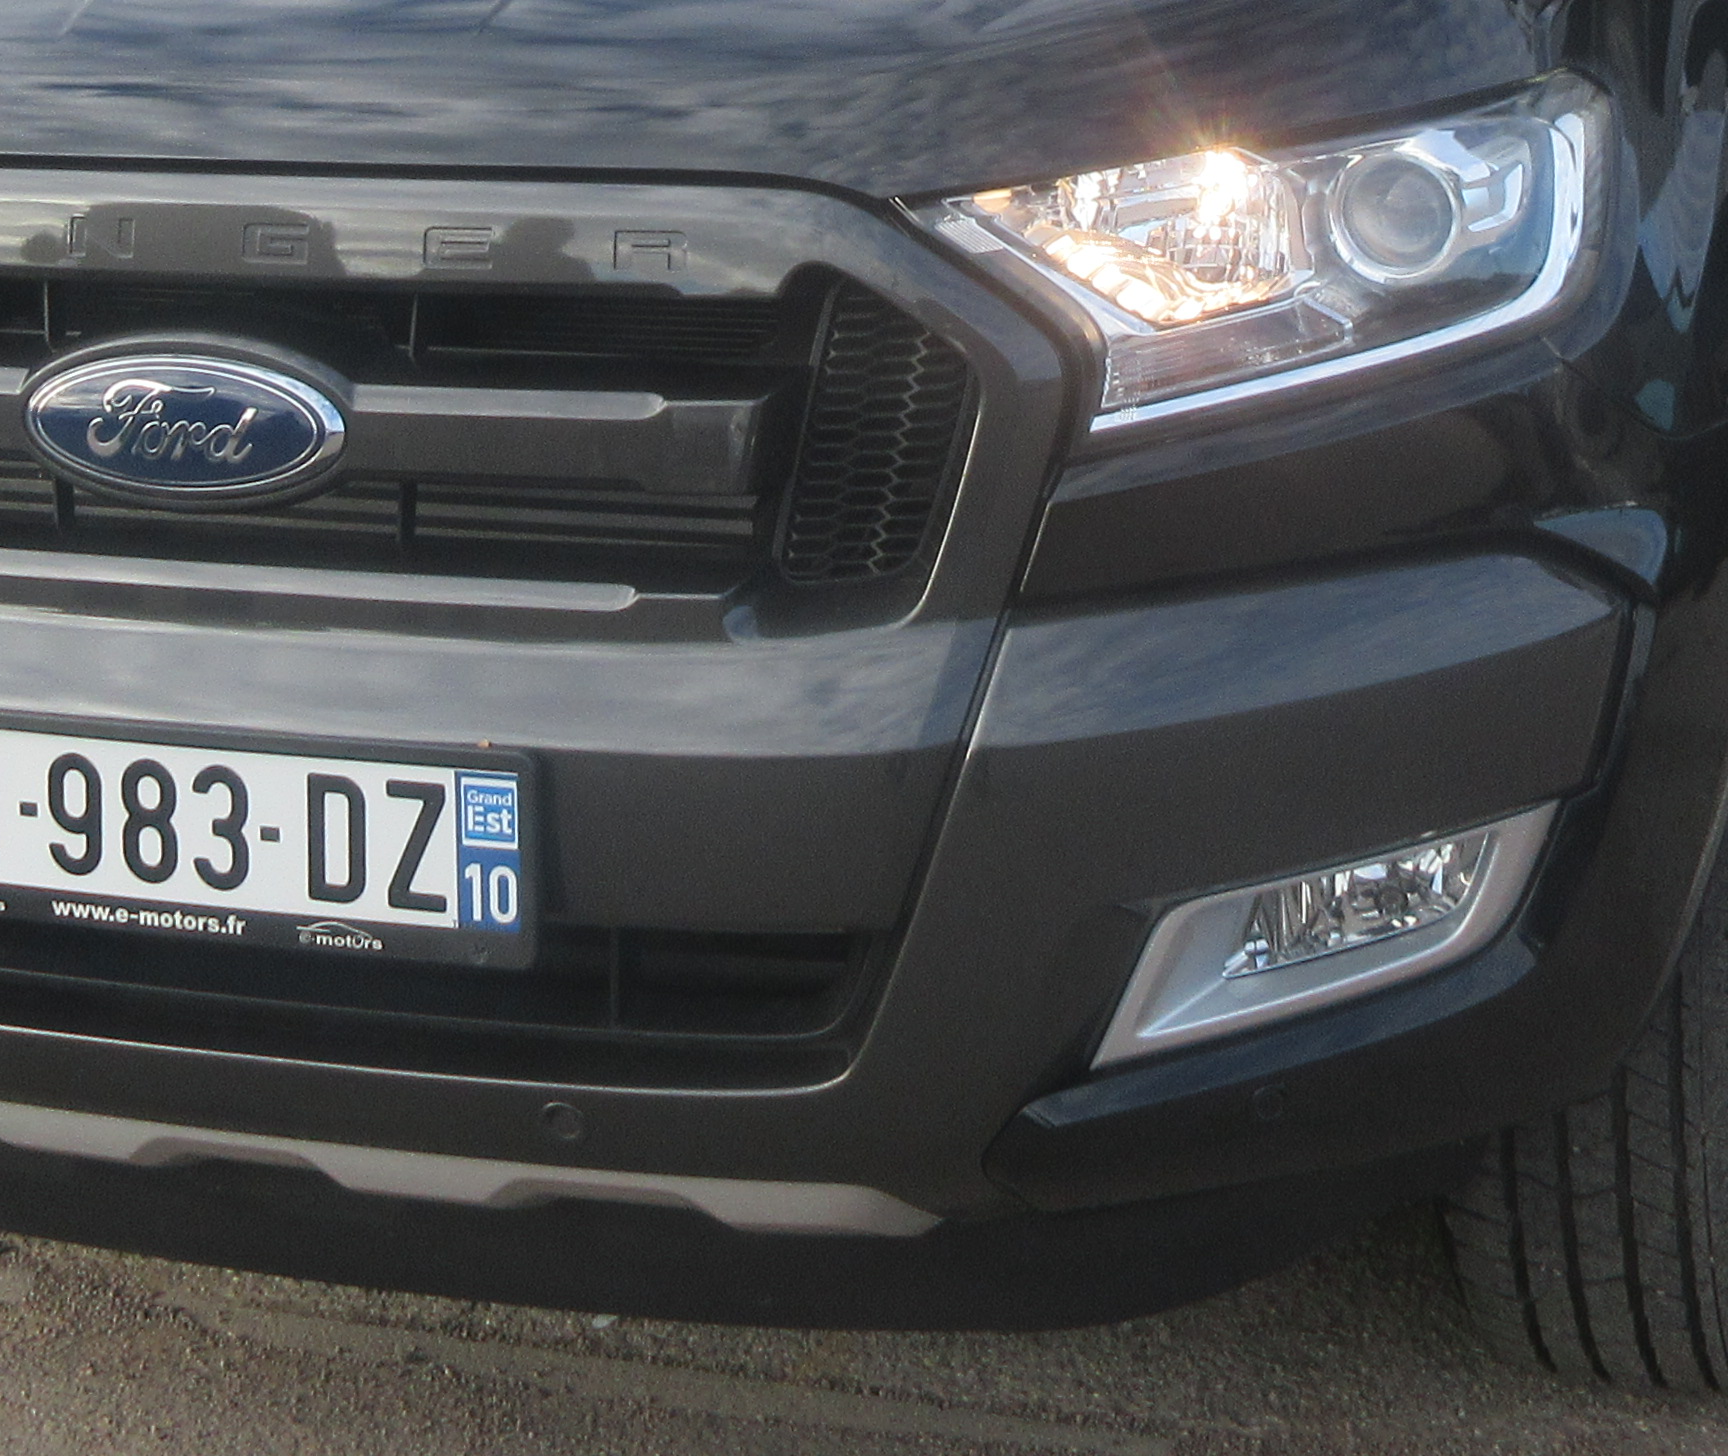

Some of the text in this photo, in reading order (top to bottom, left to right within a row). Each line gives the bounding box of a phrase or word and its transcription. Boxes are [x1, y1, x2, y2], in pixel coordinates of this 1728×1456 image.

[85, 376, 254, 465] Ford
[467, 789, 513, 807] Grand
[467, 805, 513, 835] Est
[464, 862, 518, 924] 10
[51, 899, 247, 936] www.e-motors.fr
